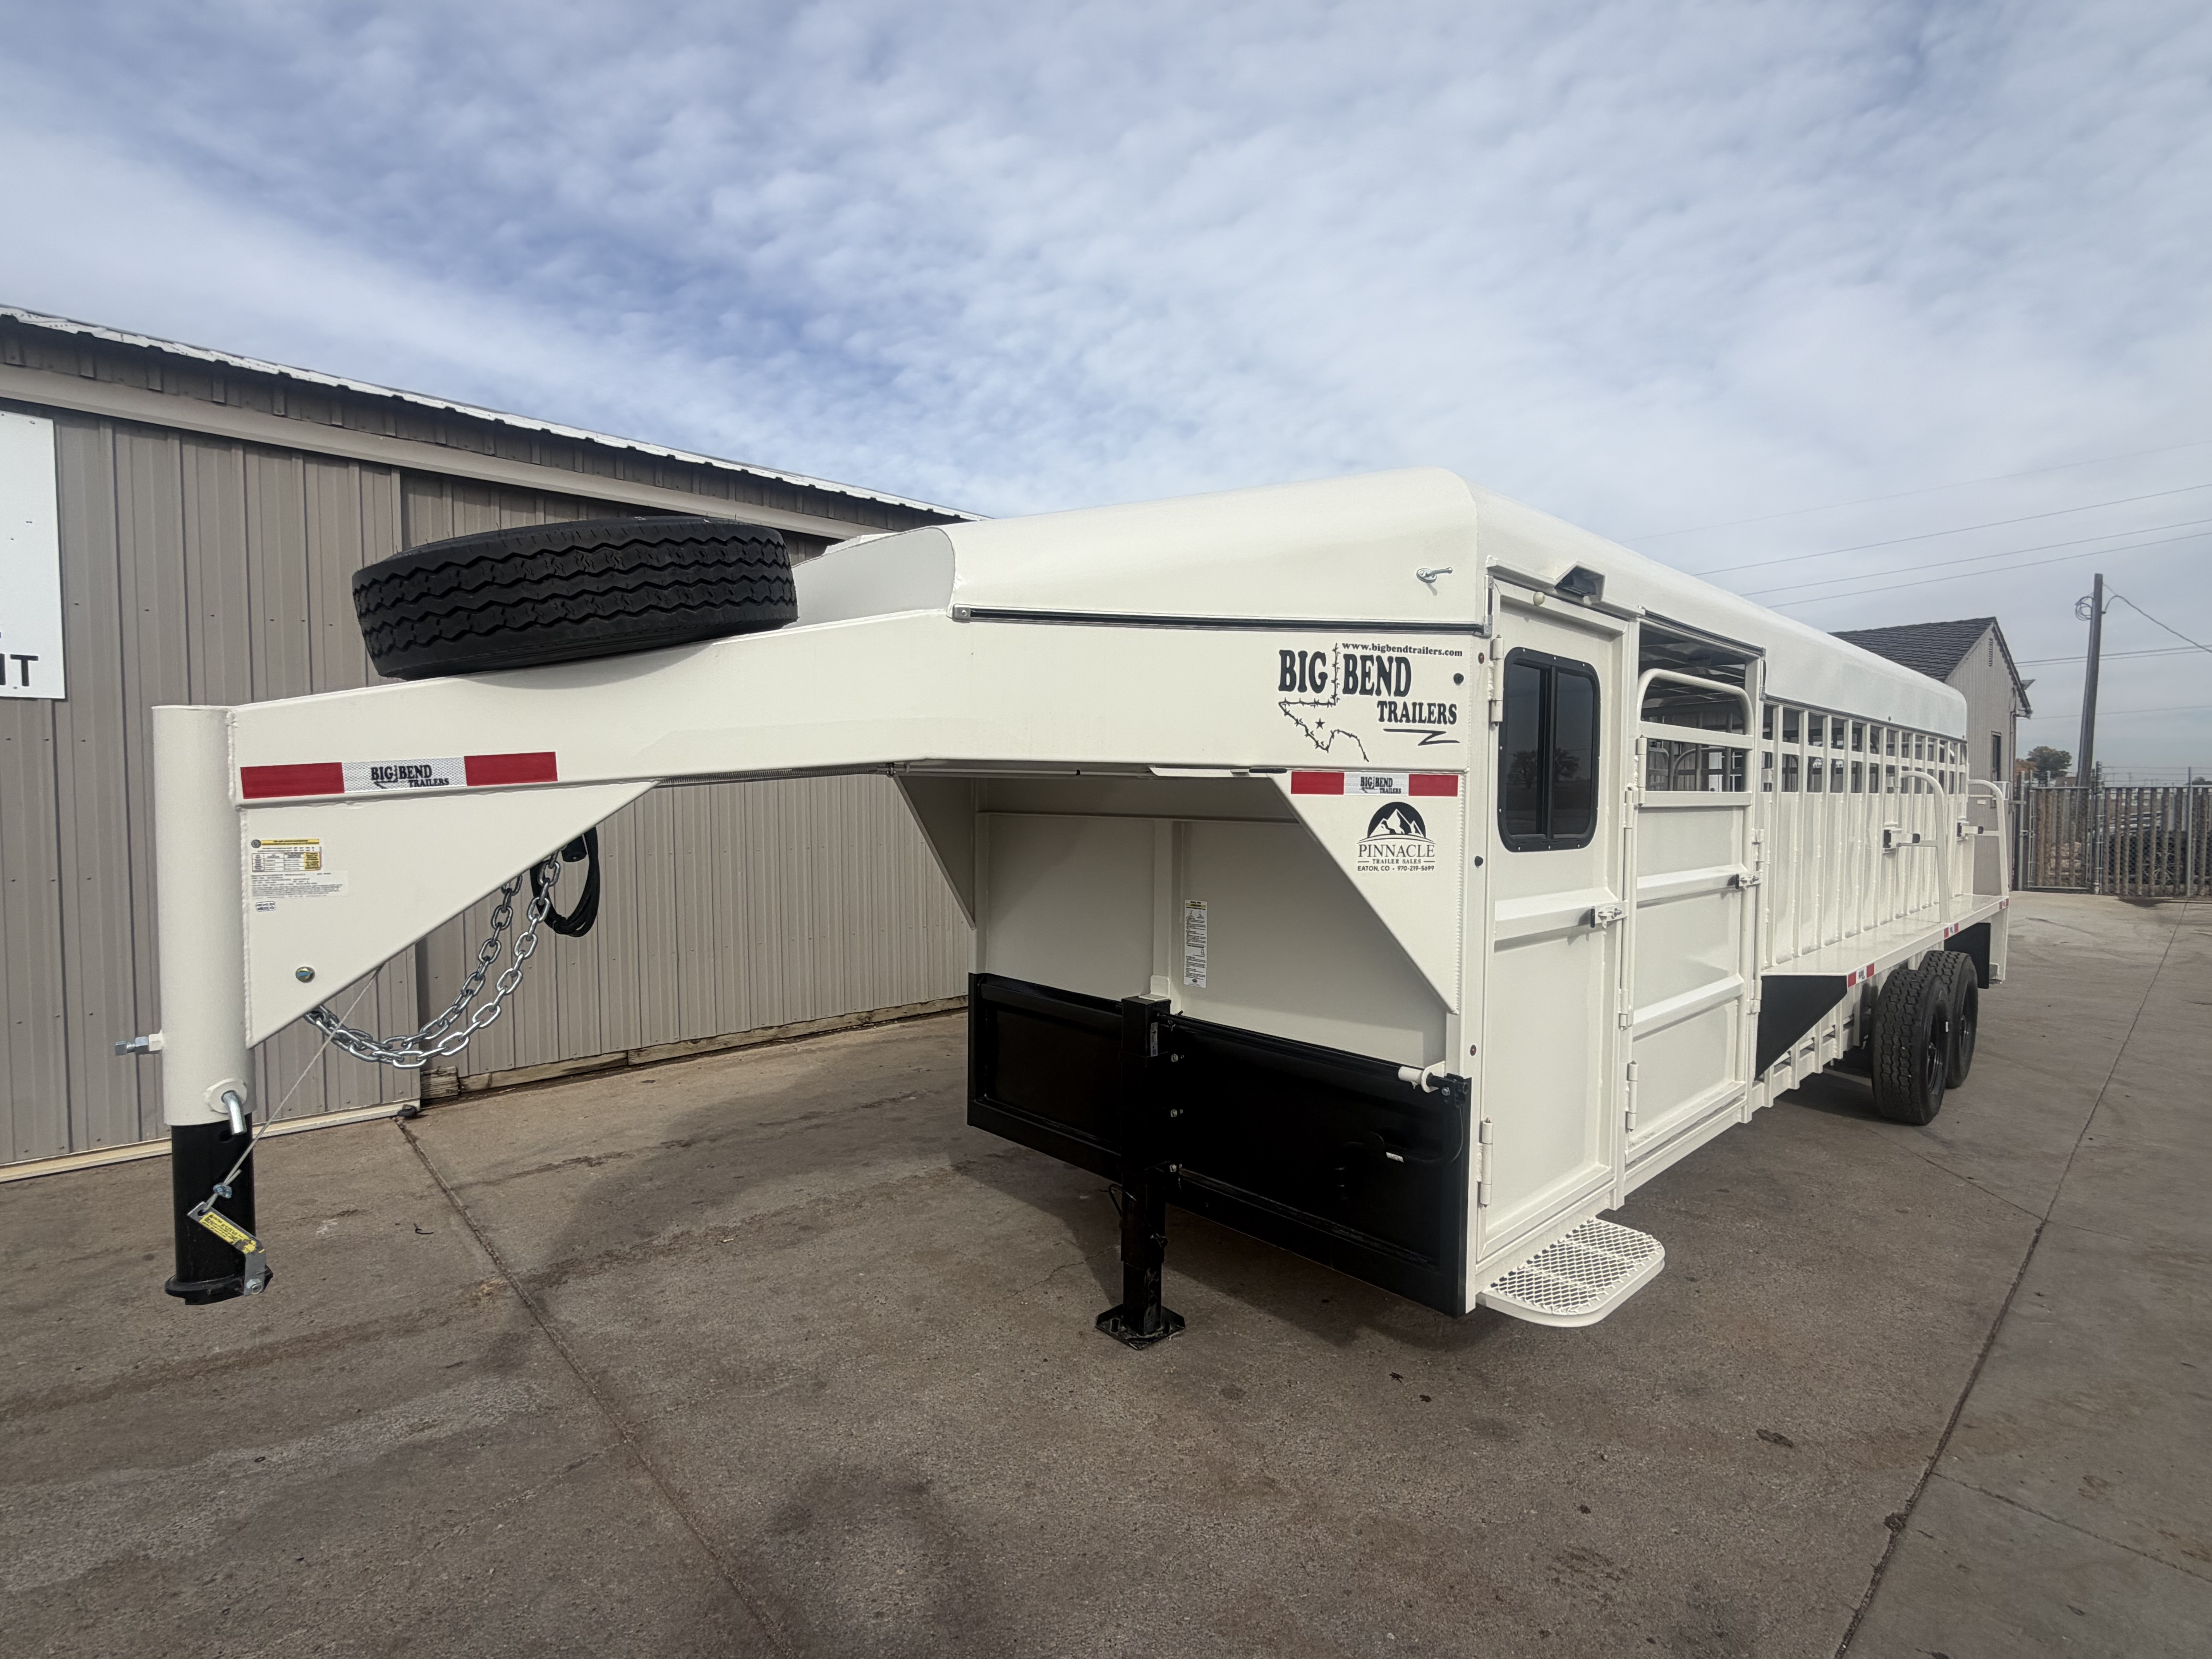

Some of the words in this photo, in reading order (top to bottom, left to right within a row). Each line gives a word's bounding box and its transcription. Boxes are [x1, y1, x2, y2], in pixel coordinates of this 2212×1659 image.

[1342, 643, 1463, 657] www.bigbendtrailers.com
[1278, 649, 1328, 694] BIG
[1342, 653, 1412, 697] BEND
[1377, 701, 1457, 725] TRAILERS
[371, 766, 394, 781] BIG
[399, 764, 433, 779] BEND
[408, 778, 450, 788] TRAILERS
[1360, 776, 1373, 787] BIG
[1375, 777, 1393, 787] BEND
[1358, 844, 1435, 857] PINNACLE
